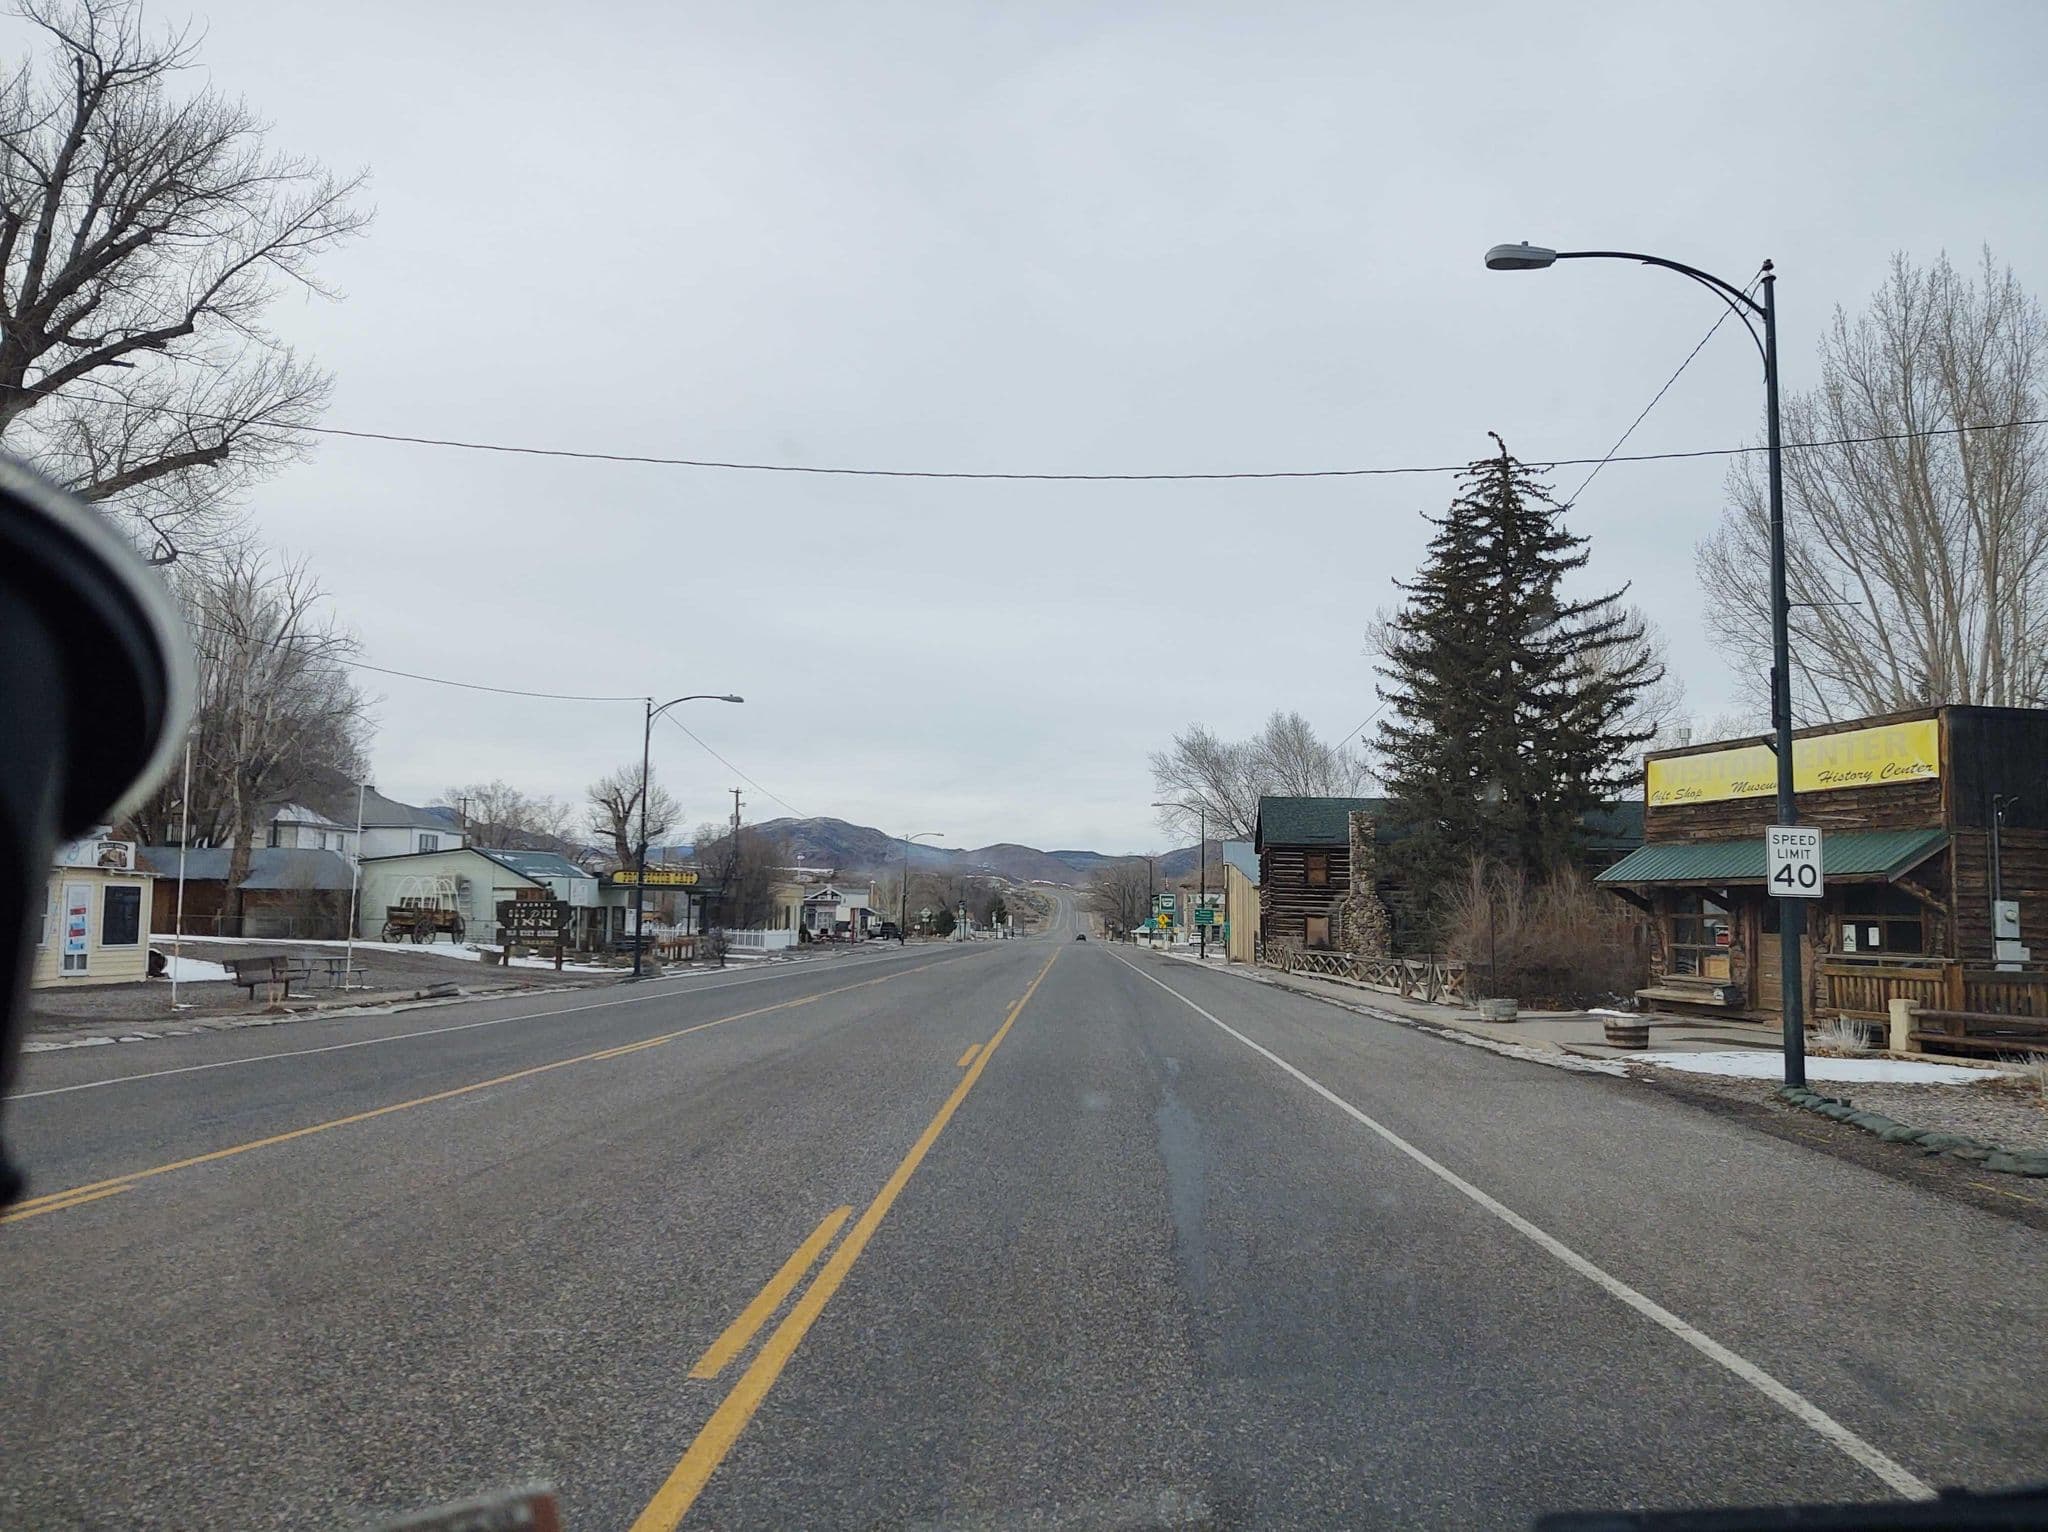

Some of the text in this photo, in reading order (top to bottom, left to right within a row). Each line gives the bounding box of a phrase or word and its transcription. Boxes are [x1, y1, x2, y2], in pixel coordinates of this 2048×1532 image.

[1799, 731, 1908, 768] ENTER
[1674, 787, 1703, 800] Shop
[1818, 769, 1874, 785] History
[1880, 762, 1934, 779] Center
[1772, 834, 1816, 846] SPEED
[1777, 848, 1811, 860] LIMIT
[1774, 863, 1817, 888] 40
[513, 918, 552, 927] INN
